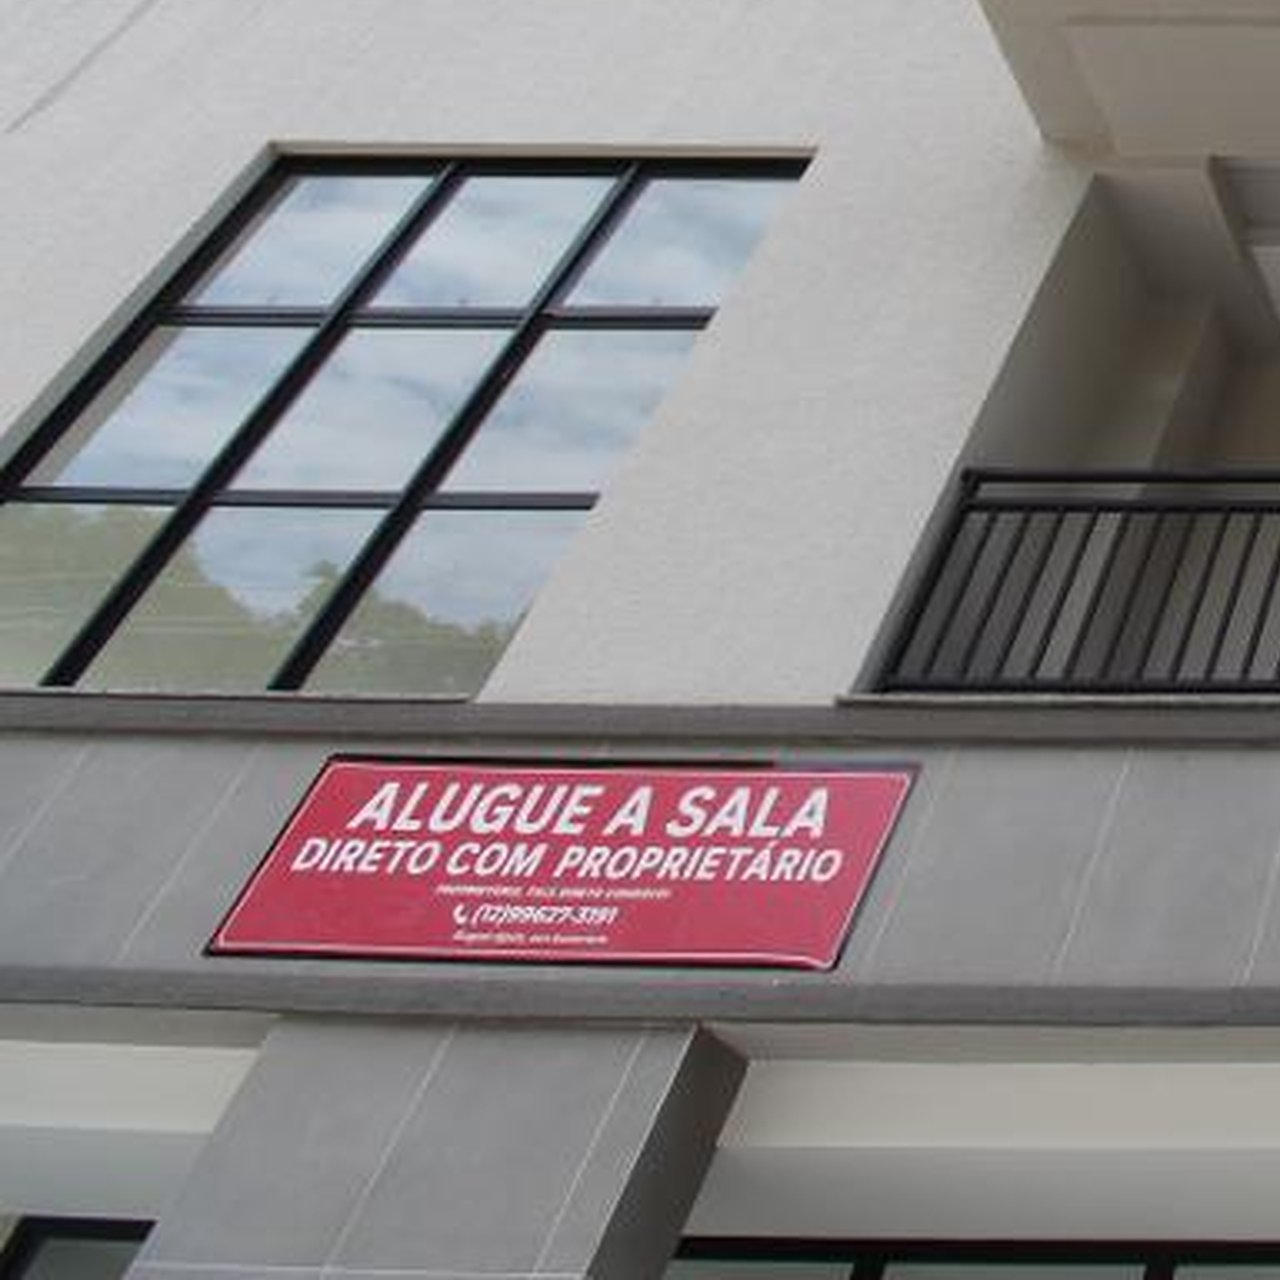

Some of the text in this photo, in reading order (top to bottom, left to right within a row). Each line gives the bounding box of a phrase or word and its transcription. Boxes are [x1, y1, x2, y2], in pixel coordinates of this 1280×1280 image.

[346, 781, 830, 838] ALUGUE A SALA
[290, 837, 844, 882] DIRETO COM PROPRIETÁRIO
